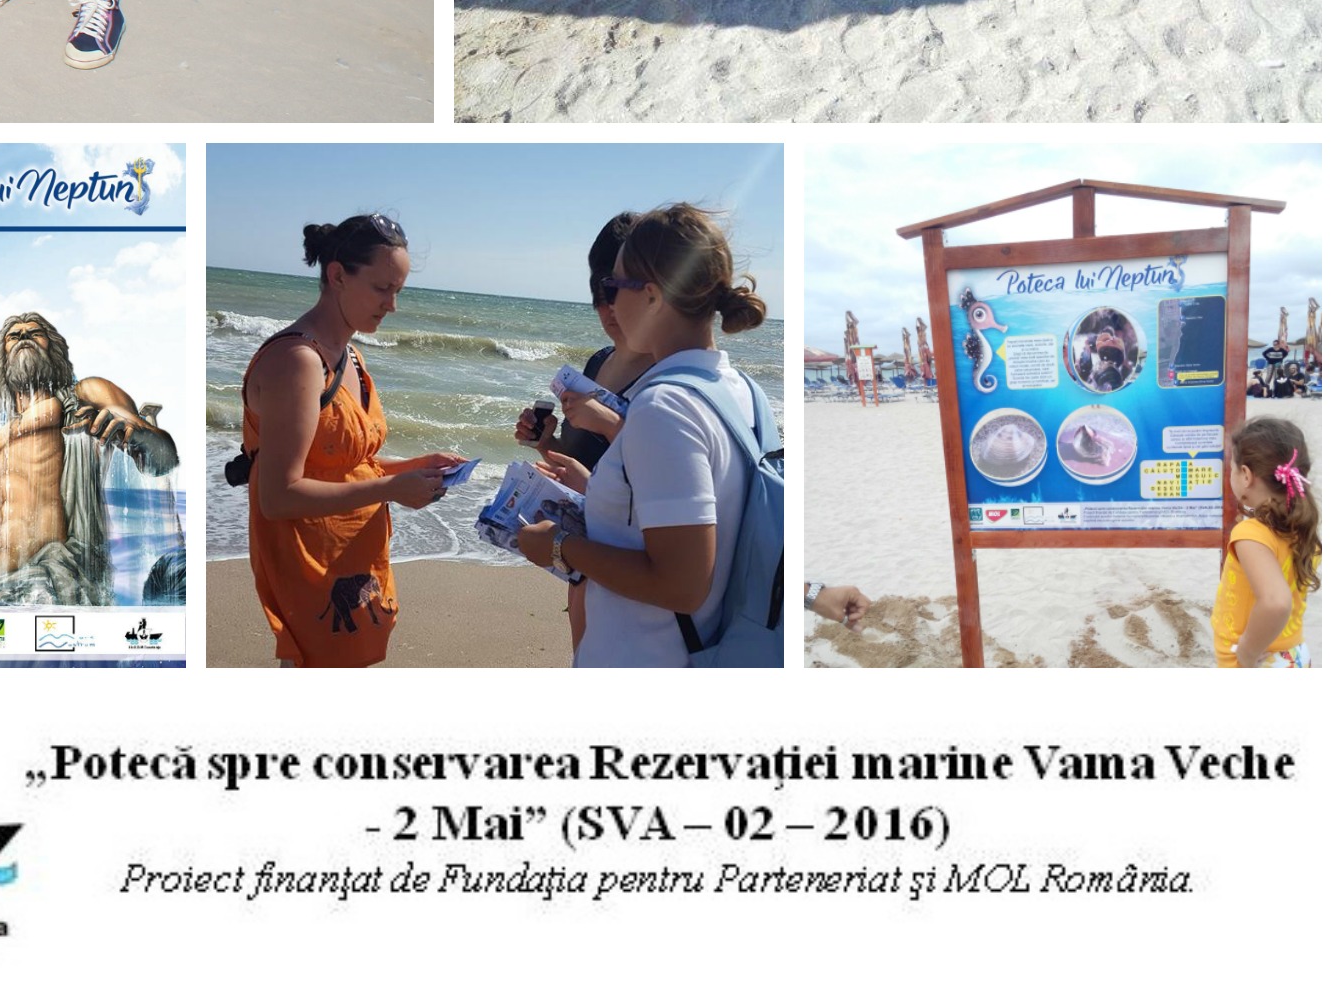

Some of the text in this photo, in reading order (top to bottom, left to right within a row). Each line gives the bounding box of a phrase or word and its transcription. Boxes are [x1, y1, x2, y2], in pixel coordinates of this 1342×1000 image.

[15, 168, 135, 209] Neptun
[996, 264, 1174, 294] Poteca lui Neptun
